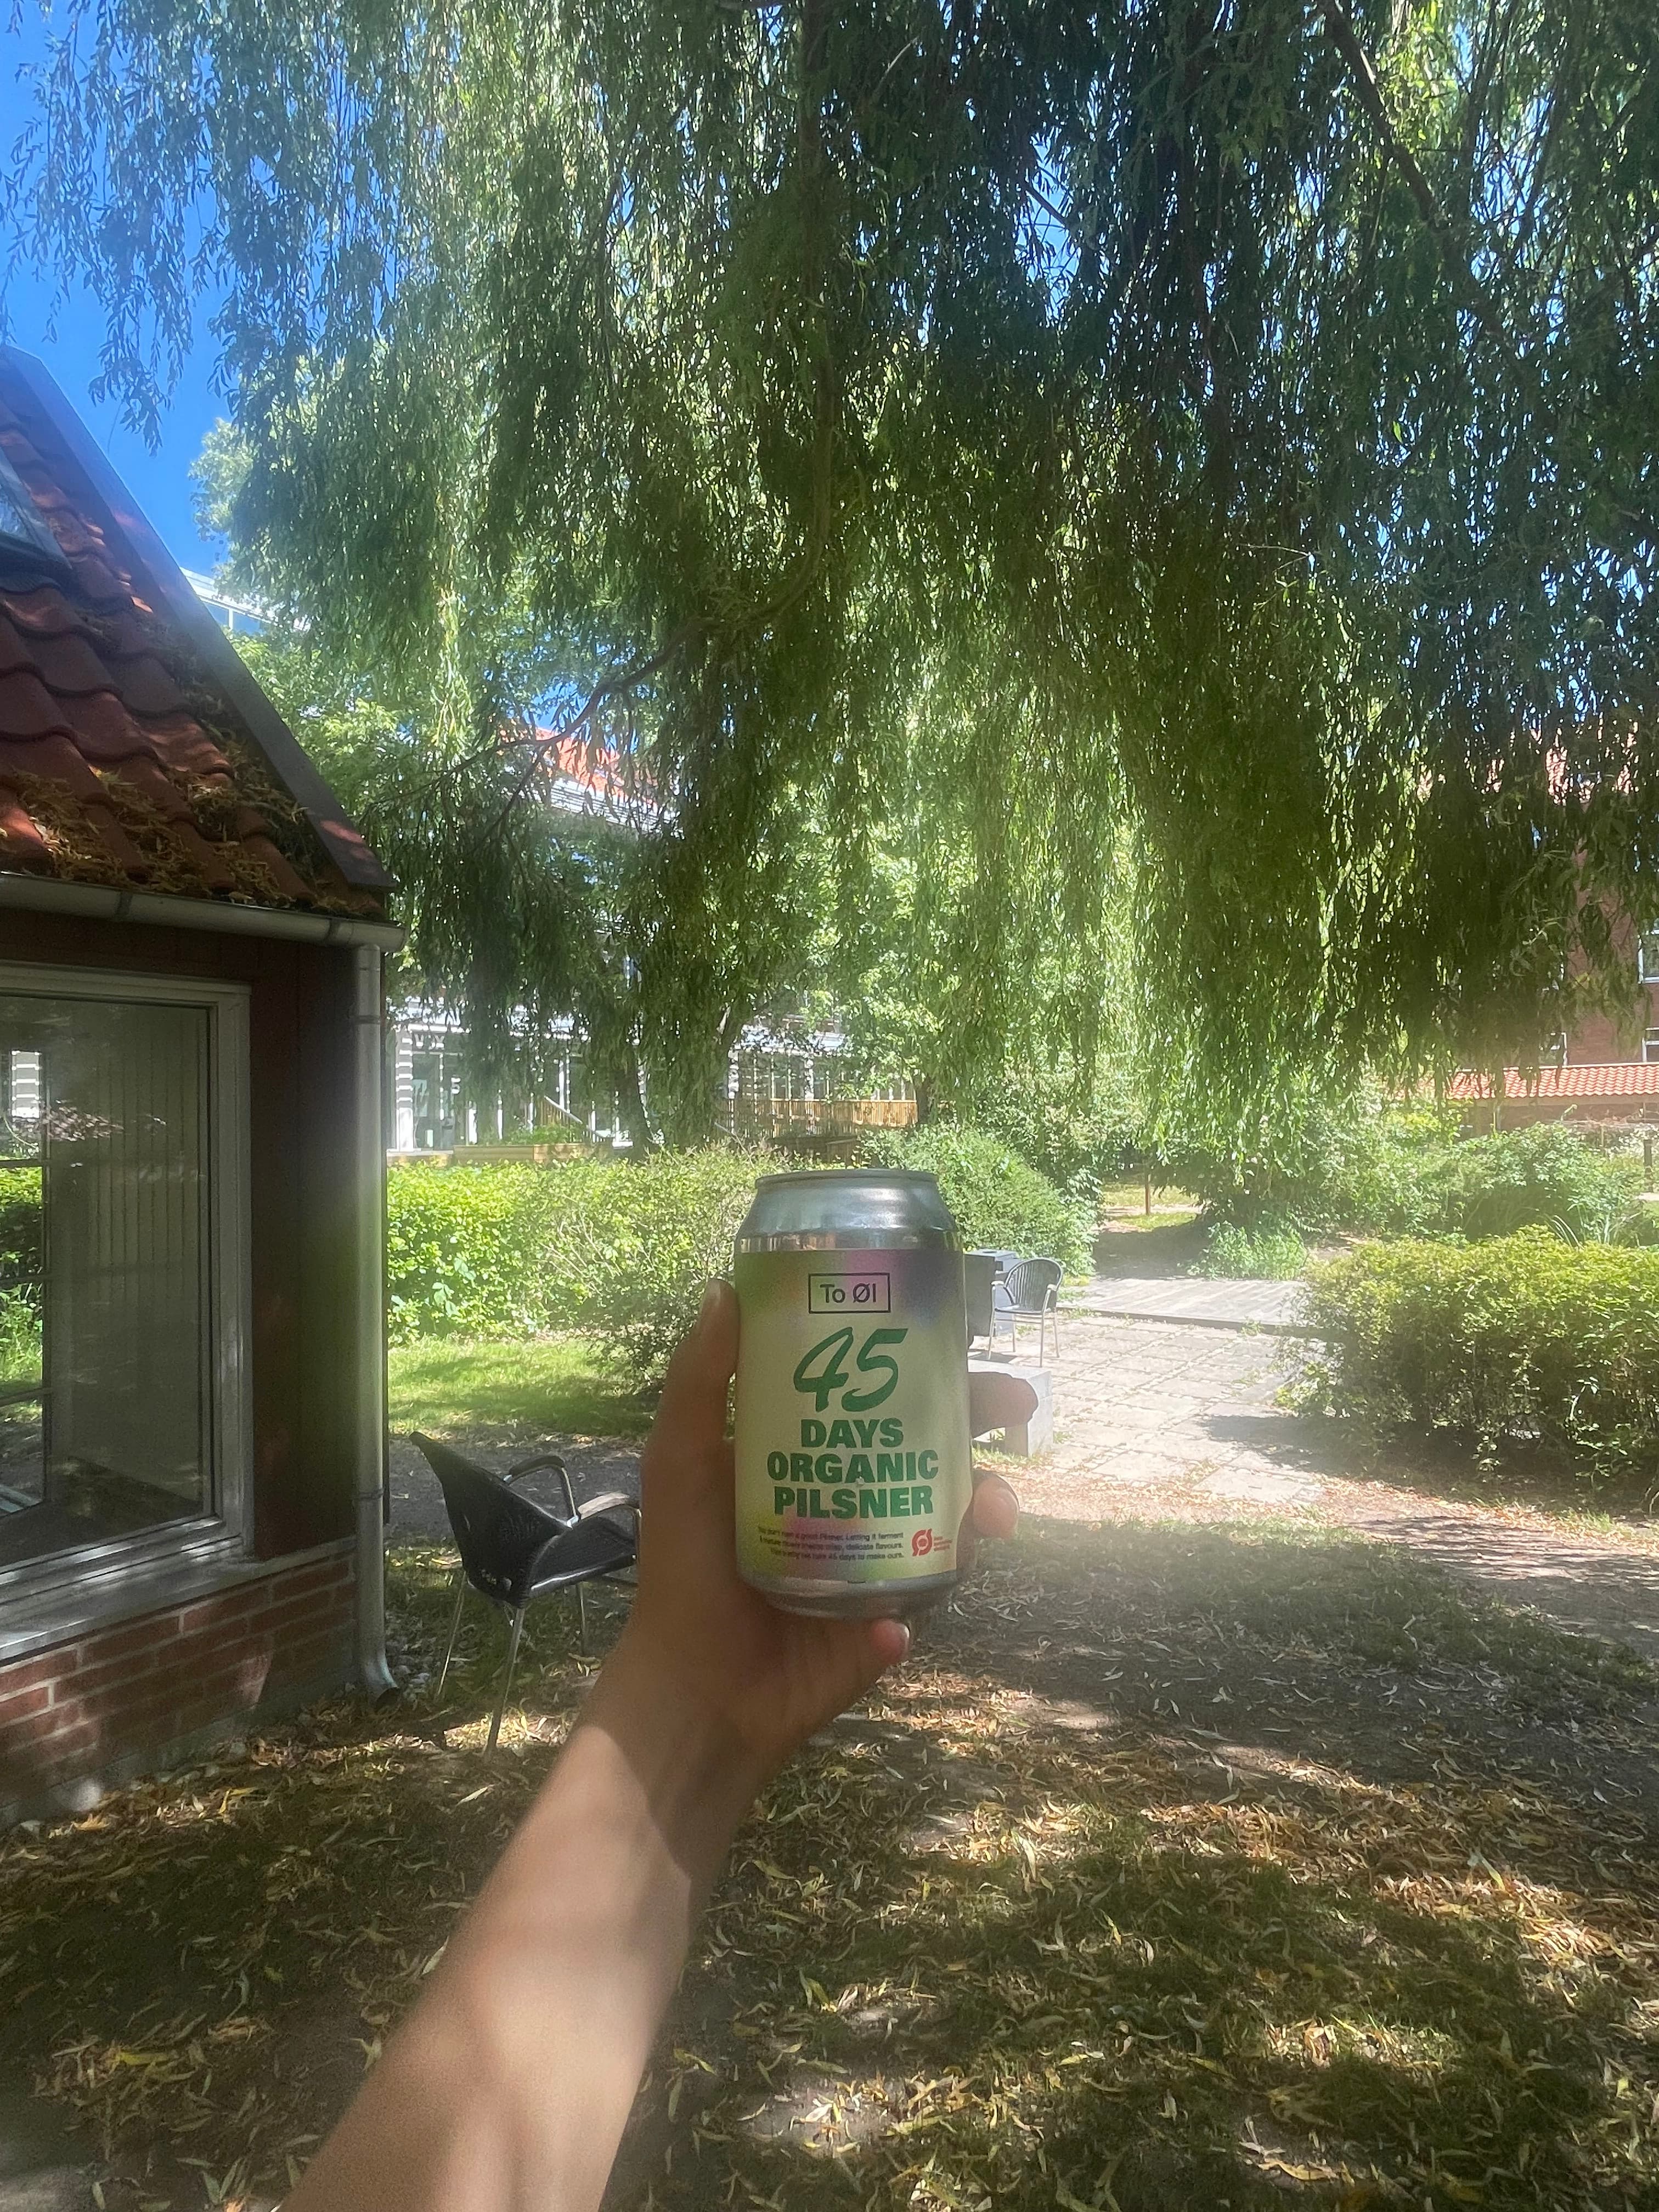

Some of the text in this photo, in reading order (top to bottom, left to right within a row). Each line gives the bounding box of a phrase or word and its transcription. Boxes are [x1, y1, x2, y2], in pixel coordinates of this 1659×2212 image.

[820, 1284, 845, 1304] To
[793, 1327, 909, 1413] 45
[800, 1418, 904, 1448] DAYS
[768, 1449, 939, 1483] ORGANIC
[774, 1485, 934, 1519] PILSNER
[839, 1553, 856, 1561] days
